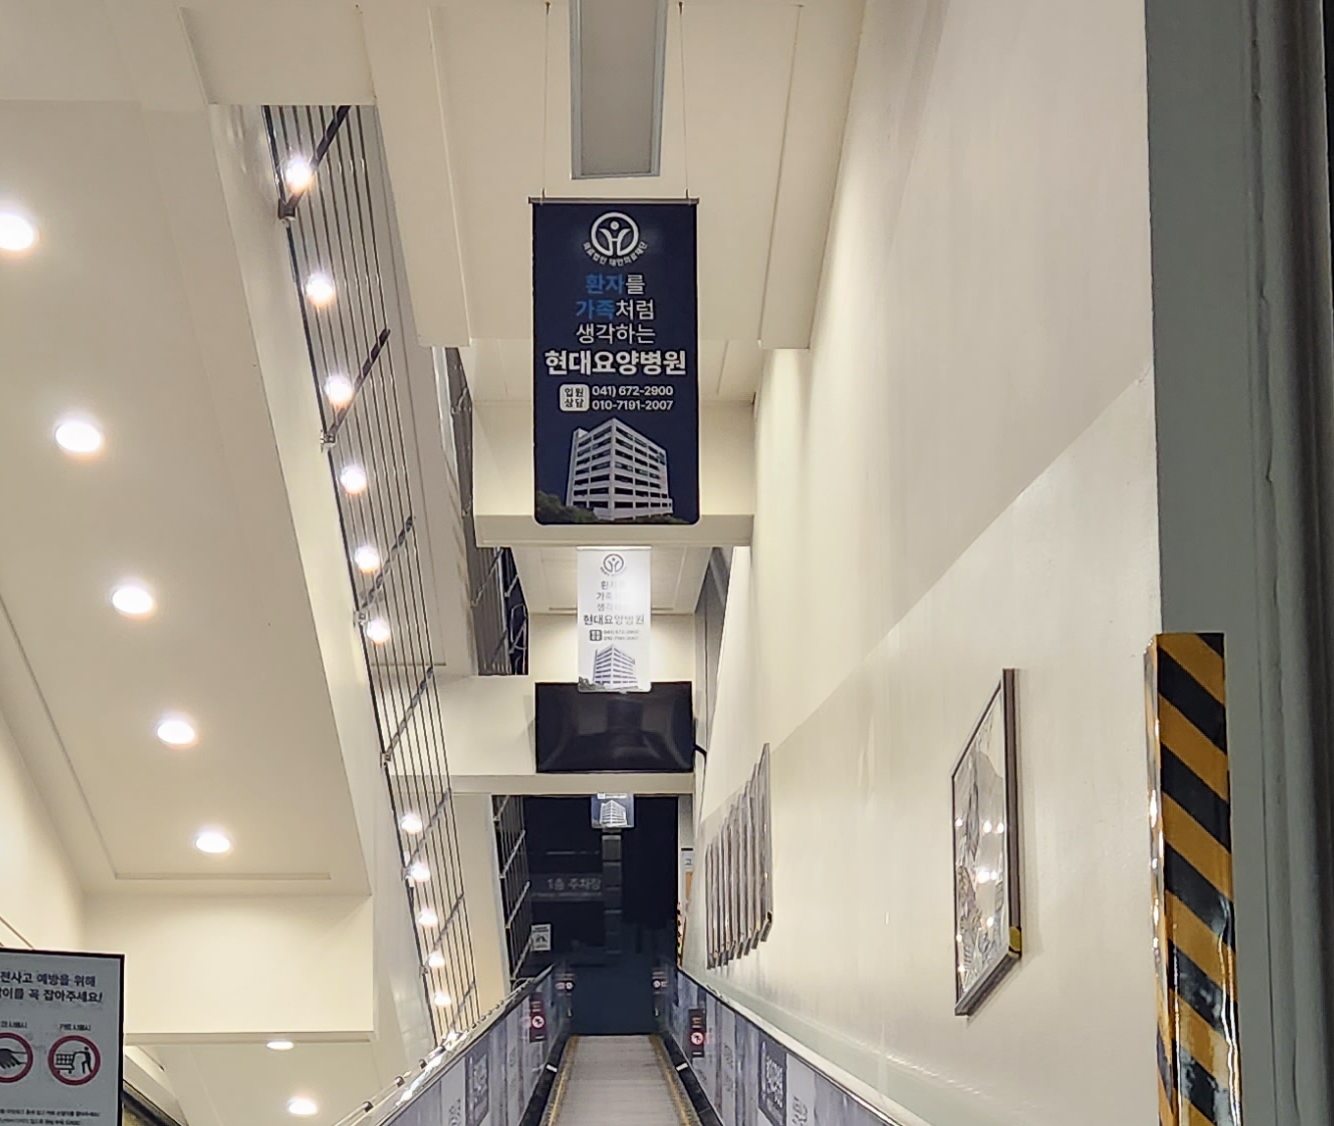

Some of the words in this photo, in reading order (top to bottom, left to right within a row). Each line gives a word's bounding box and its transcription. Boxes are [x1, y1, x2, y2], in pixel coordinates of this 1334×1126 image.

[585, 273, 645, 295] 환자를
[576, 299, 655, 320] 가족처럼
[576, 323, 655, 345] 생각하는
[545, 350, 687, 376] 현대요양병원
[592, 385, 616, 397] 041)
[618, 385, 673, 396] 672-2900
[592, 400, 673, 411] 010-7191-2007
[37, 973, 70, 987] 예방을
[74, 975, 96, 988] 위해
[28, 988, 40, 1001] 꼭
[44, 989, 103, 1003] 잡아주세요!
